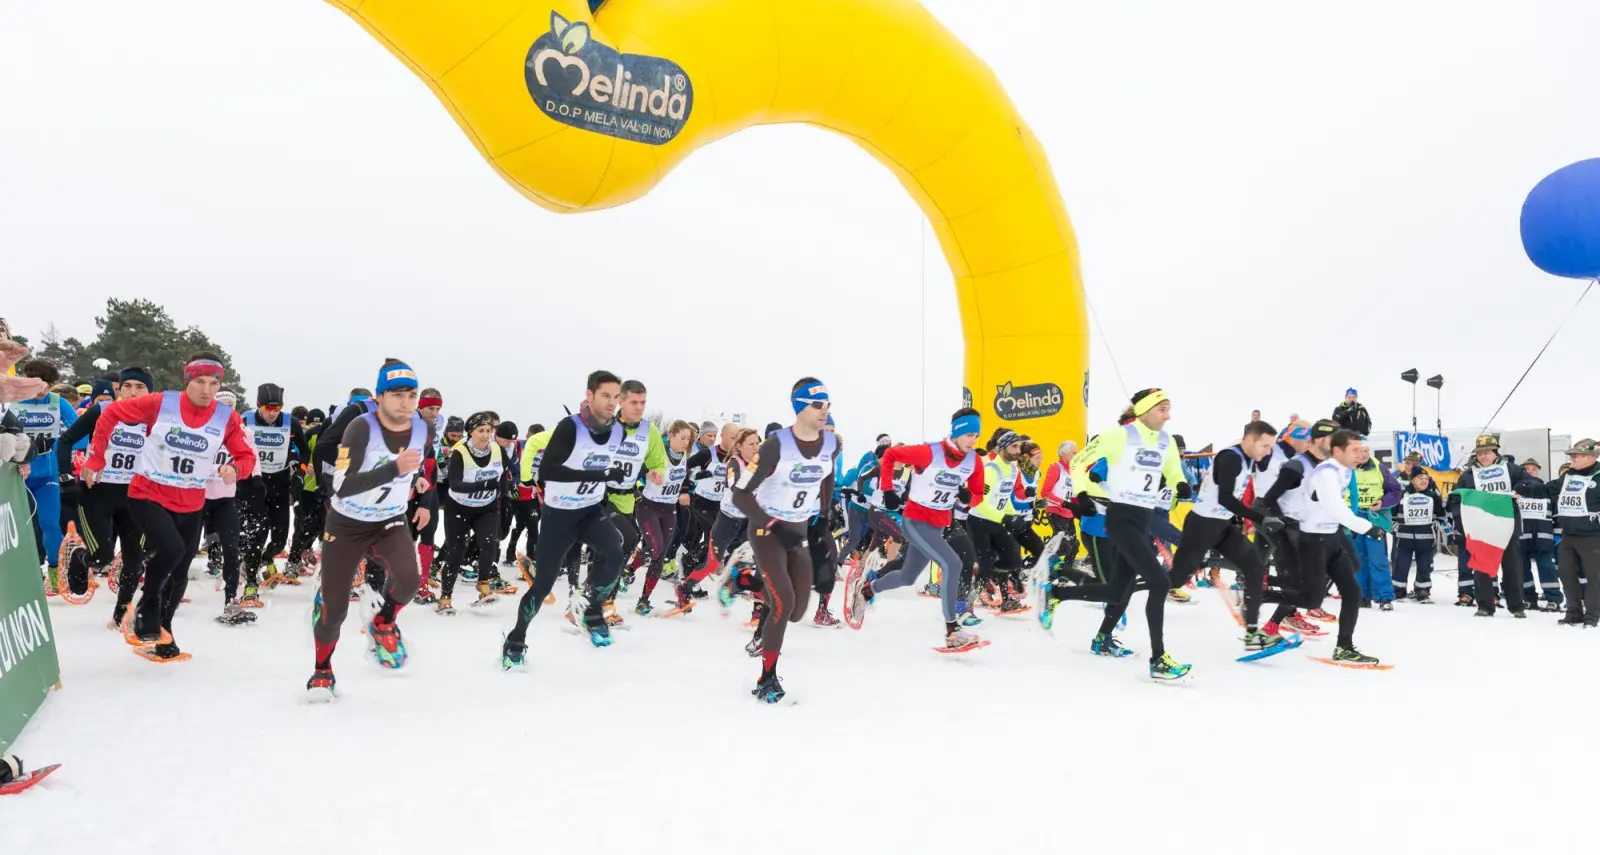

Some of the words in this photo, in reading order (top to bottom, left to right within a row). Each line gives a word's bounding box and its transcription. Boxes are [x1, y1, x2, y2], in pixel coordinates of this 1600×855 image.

[546, 100, 582, 118] D.O.P
[584, 110, 617, 127] MELA
[620, 119, 640, 133] VAL
[641, 123, 651, 135] DI
[653, 127, 673, 139] NON
[18, 411, 53, 424] Melinda
[113, 432, 144, 446] Melinda
[166, 431, 207, 450] Melinda
[111, 452, 136, 470] 68
[170, 456, 195, 474] 16
[576, 481, 600, 495] 62
[1143, 473, 1153, 492] 2
[1480, 481, 1507, 491] 2070
[375, 487, 392, 504] 7
[792, 490, 808, 509] 8
[931, 490, 952, 504] 24
[1560, 496, 1582, 507] 3463
[1408, 508, 1429, 517] 3274
[8, 599, 51, 661] NON
